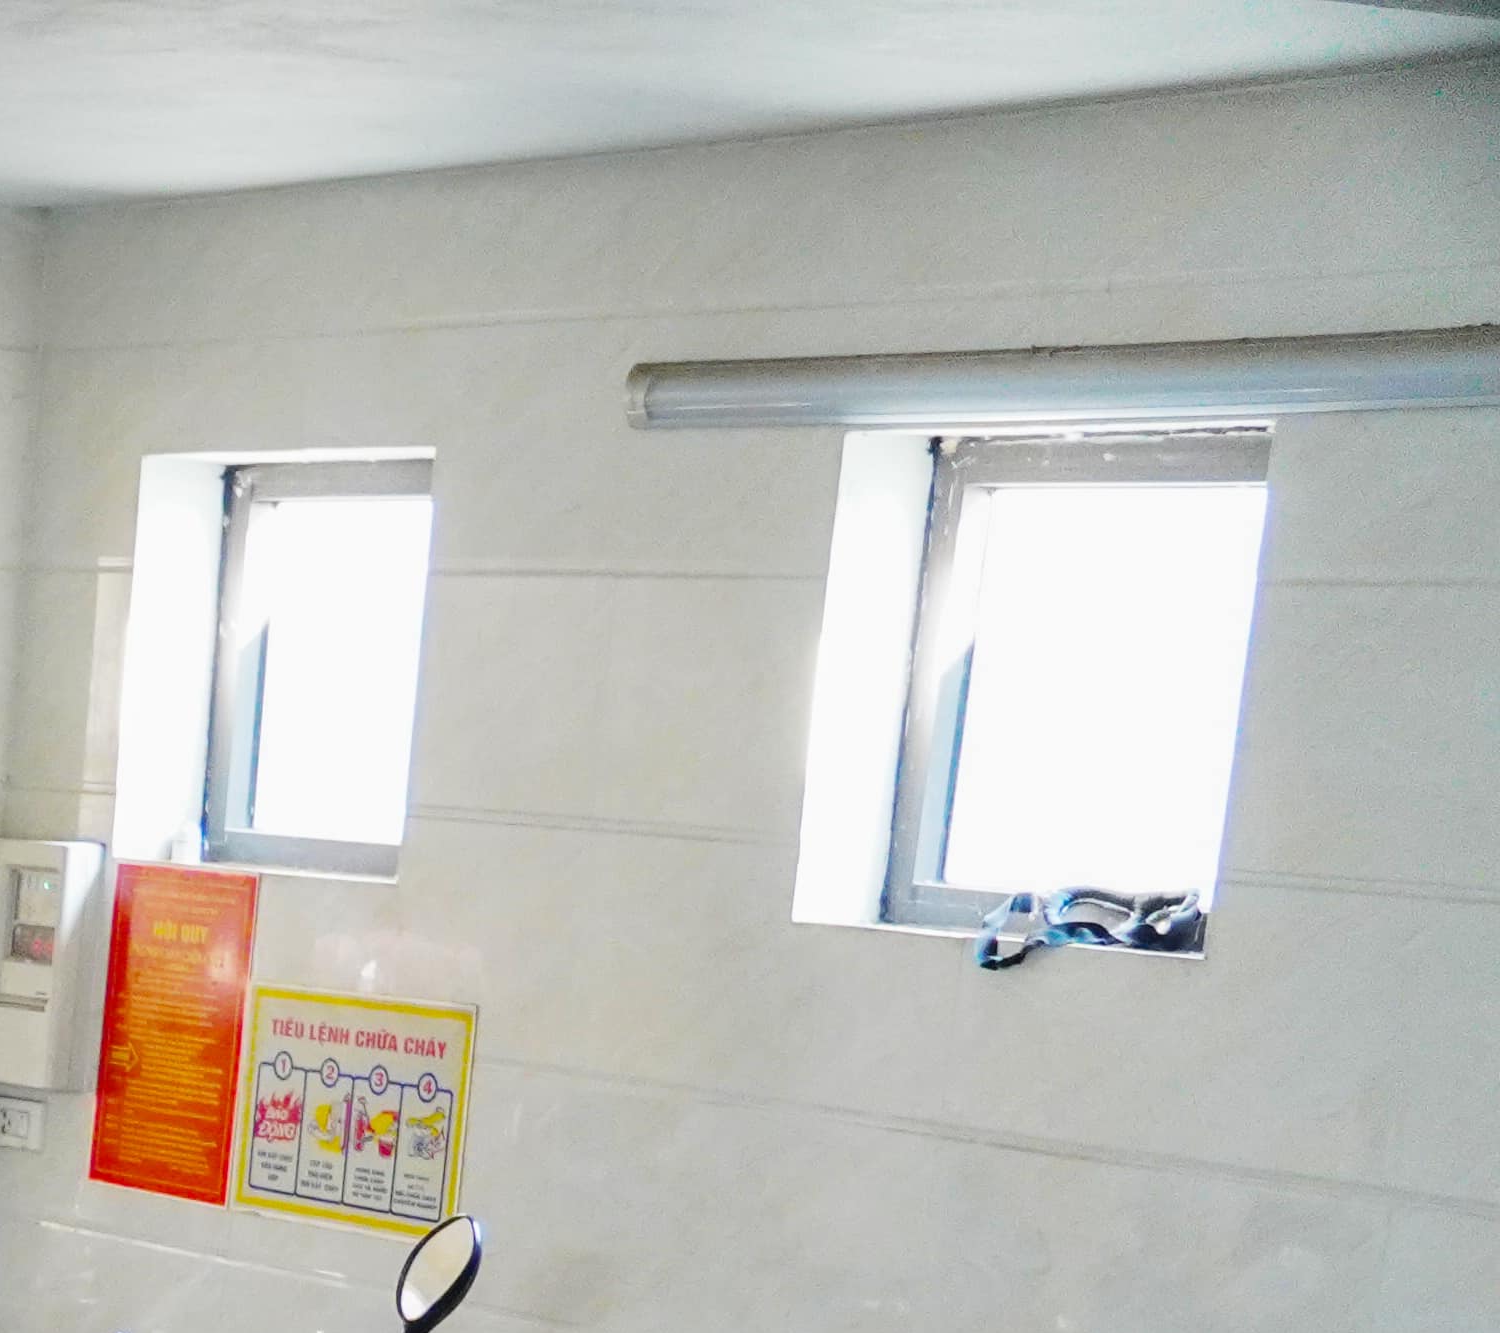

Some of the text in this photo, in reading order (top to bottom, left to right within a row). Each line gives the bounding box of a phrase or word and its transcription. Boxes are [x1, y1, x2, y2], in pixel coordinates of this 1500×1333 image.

[309, 1022, 349, 1046] LỆNH
[355, 1028, 398, 1051] CHỮA
[404, 1036, 447, 1059] CHÁY
[327, 1065, 335, 1080] 2
[376, 1072, 384, 1087] 3
[422, 1079, 432, 1095] 4
